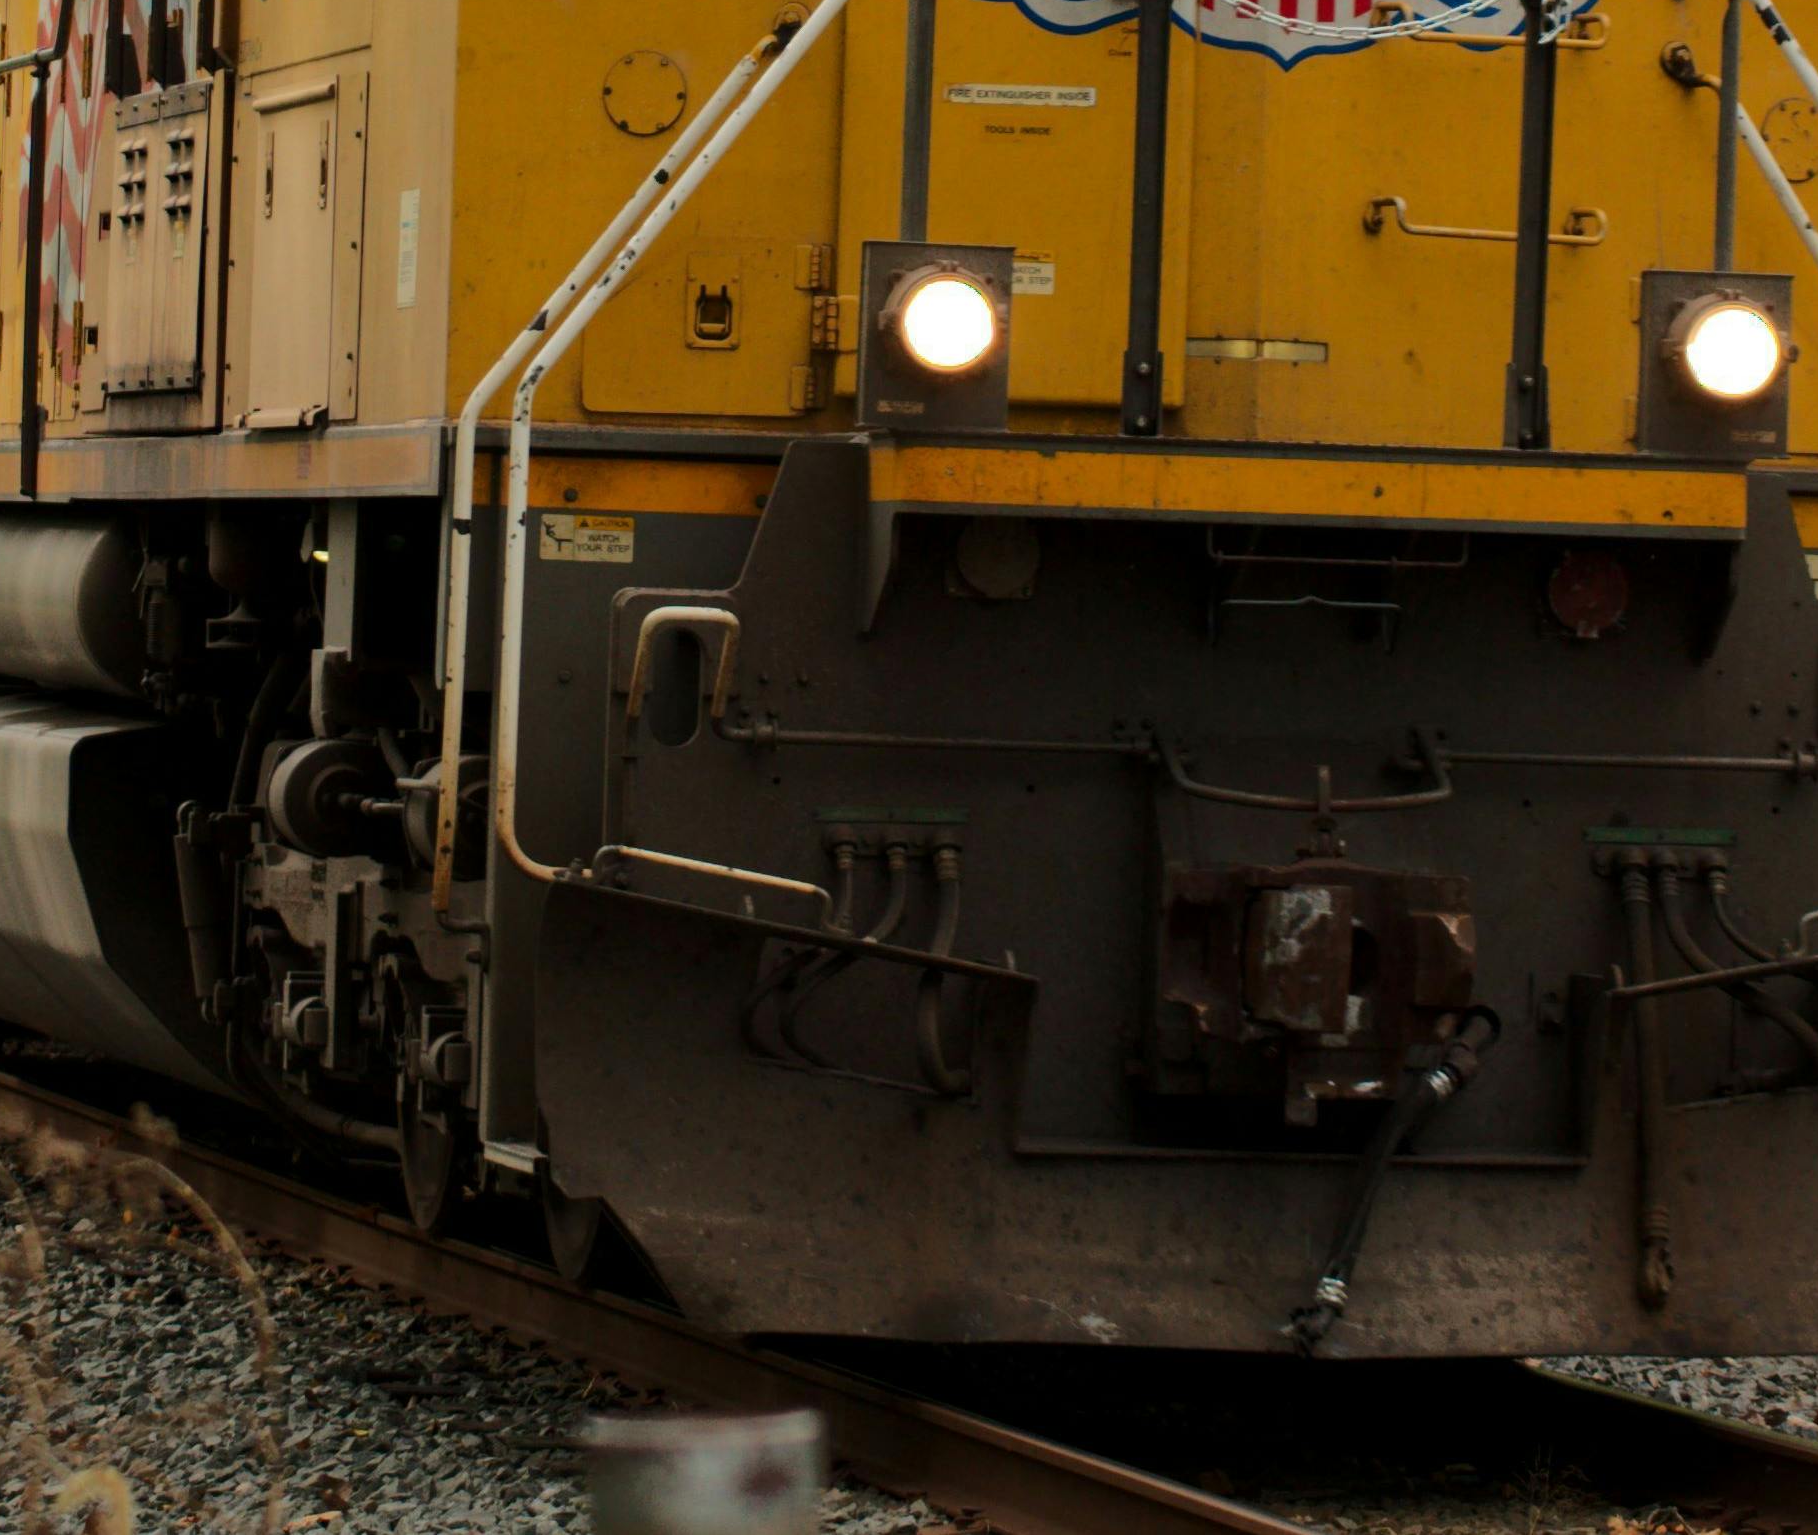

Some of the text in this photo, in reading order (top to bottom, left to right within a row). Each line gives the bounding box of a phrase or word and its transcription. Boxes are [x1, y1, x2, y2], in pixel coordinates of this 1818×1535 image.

[948, 88, 1091, 101] FIRE EXTINGUISHER INSIDE
[985, 125, 1052, 136] TOOLS INSIDE
[592, 519, 630, 528] CAUTION
[588, 534, 620, 543] WATCH
[576, 543, 630, 554] YOUR STEP
